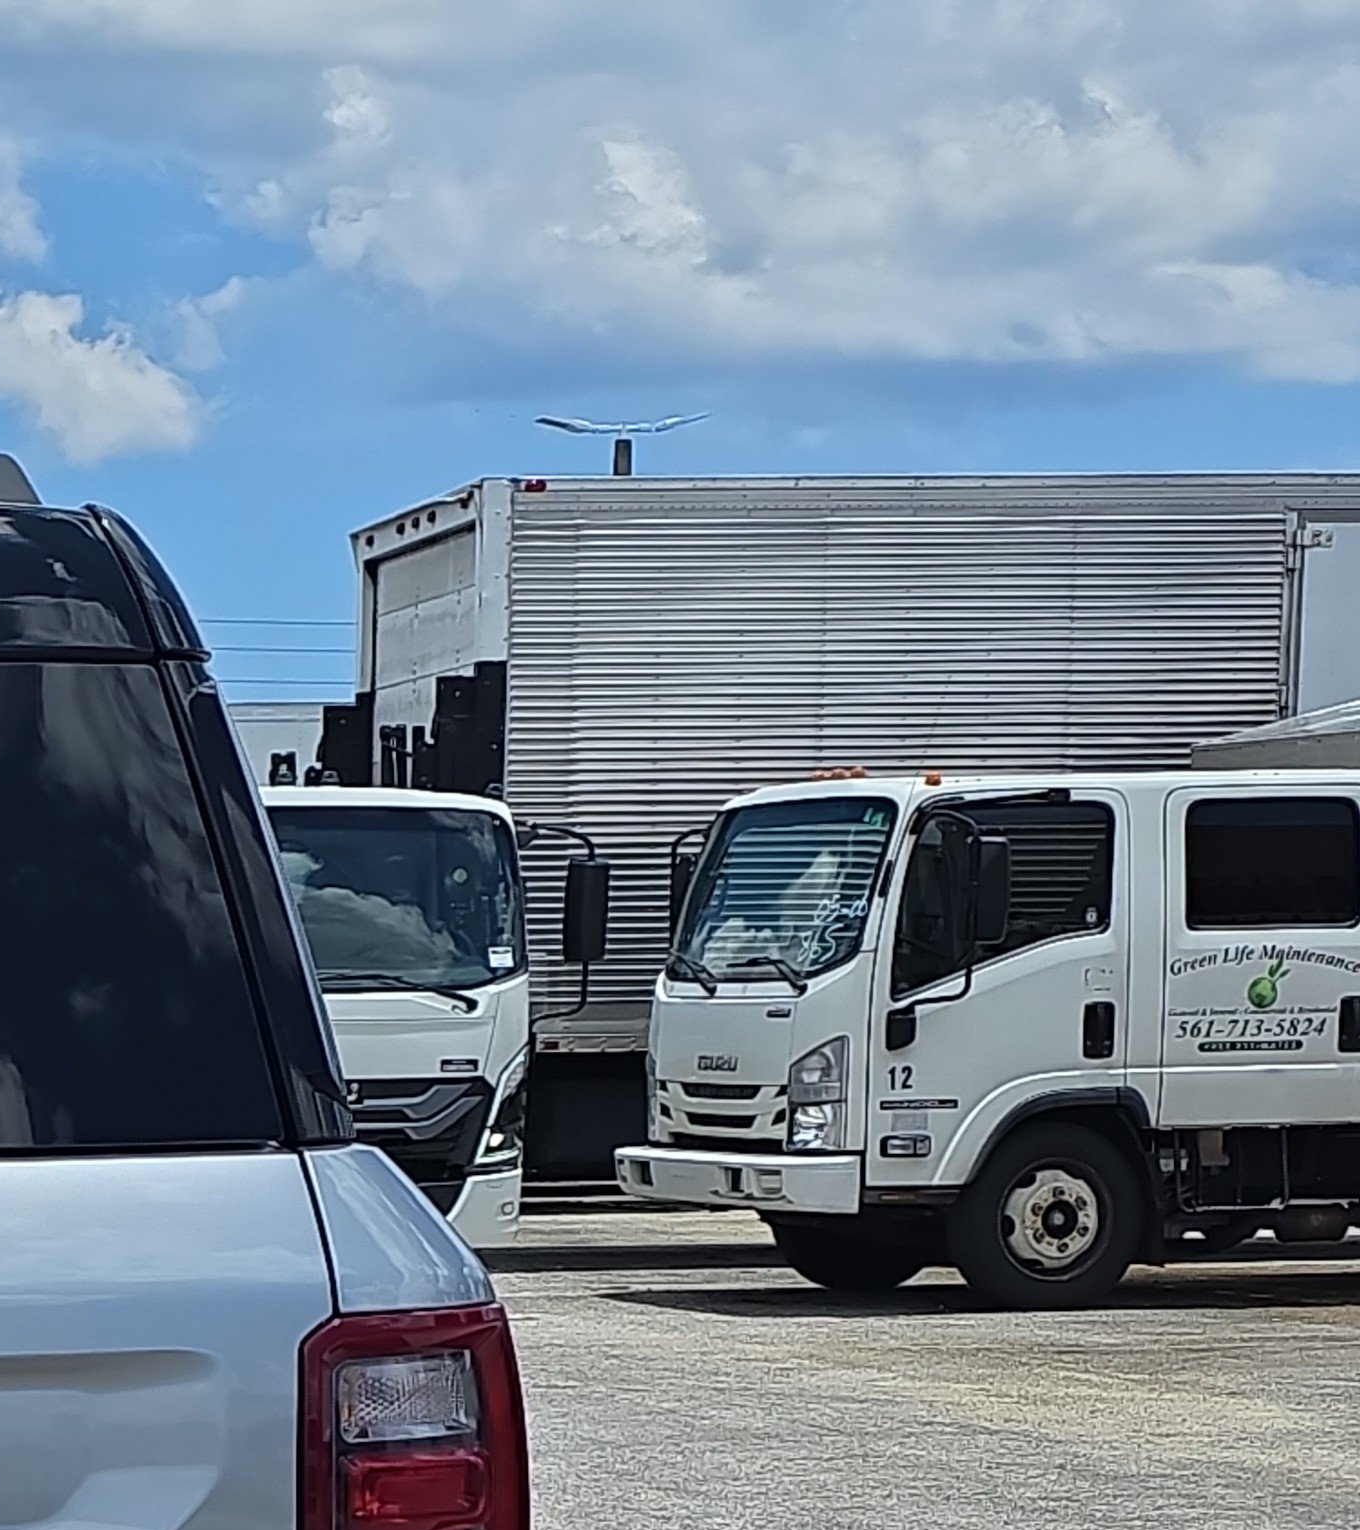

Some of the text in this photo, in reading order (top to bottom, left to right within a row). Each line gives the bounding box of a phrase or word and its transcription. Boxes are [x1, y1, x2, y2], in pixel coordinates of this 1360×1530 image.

[1169, 945, 1360, 977] Green Life Maintenance
[1174, 1017, 1328, 1039] 561-713-5824
[887, 1065, 914, 1091] 12
